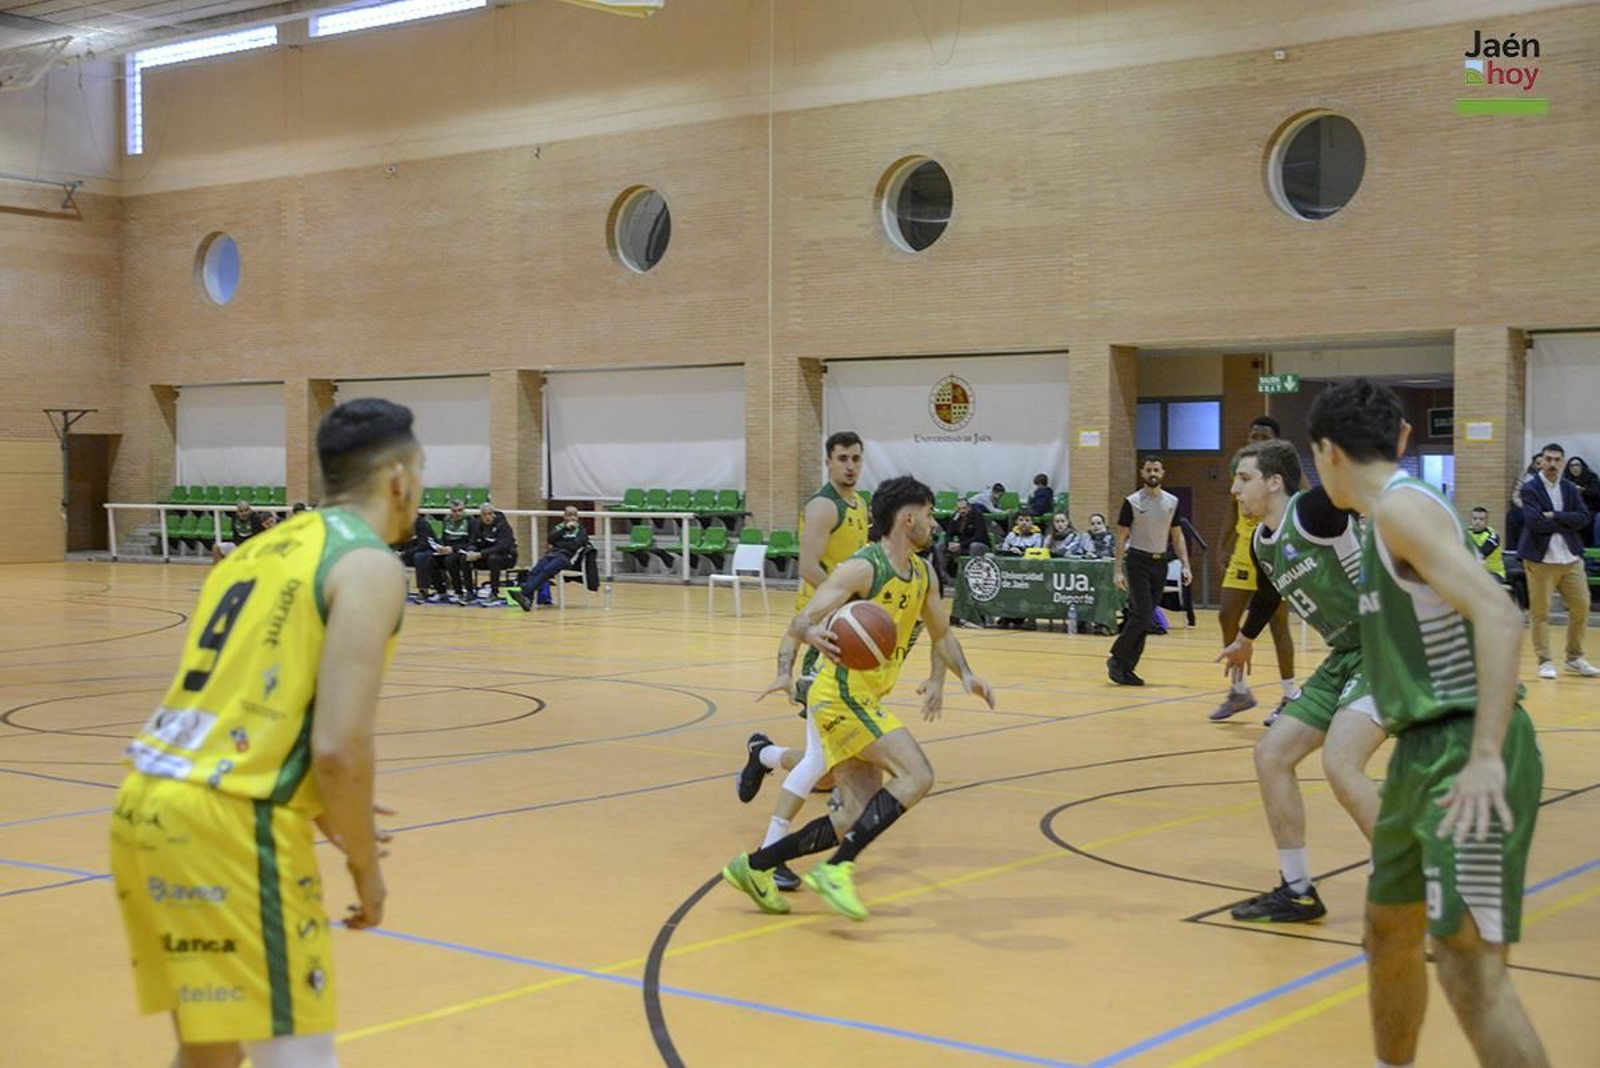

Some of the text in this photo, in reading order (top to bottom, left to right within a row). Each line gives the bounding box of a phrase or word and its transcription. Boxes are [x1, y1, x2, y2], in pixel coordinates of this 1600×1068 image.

[1053, 592, 1095, 606] Deporte
[1288, 588, 1318, 619] 13
[182, 578, 256, 692] 9
